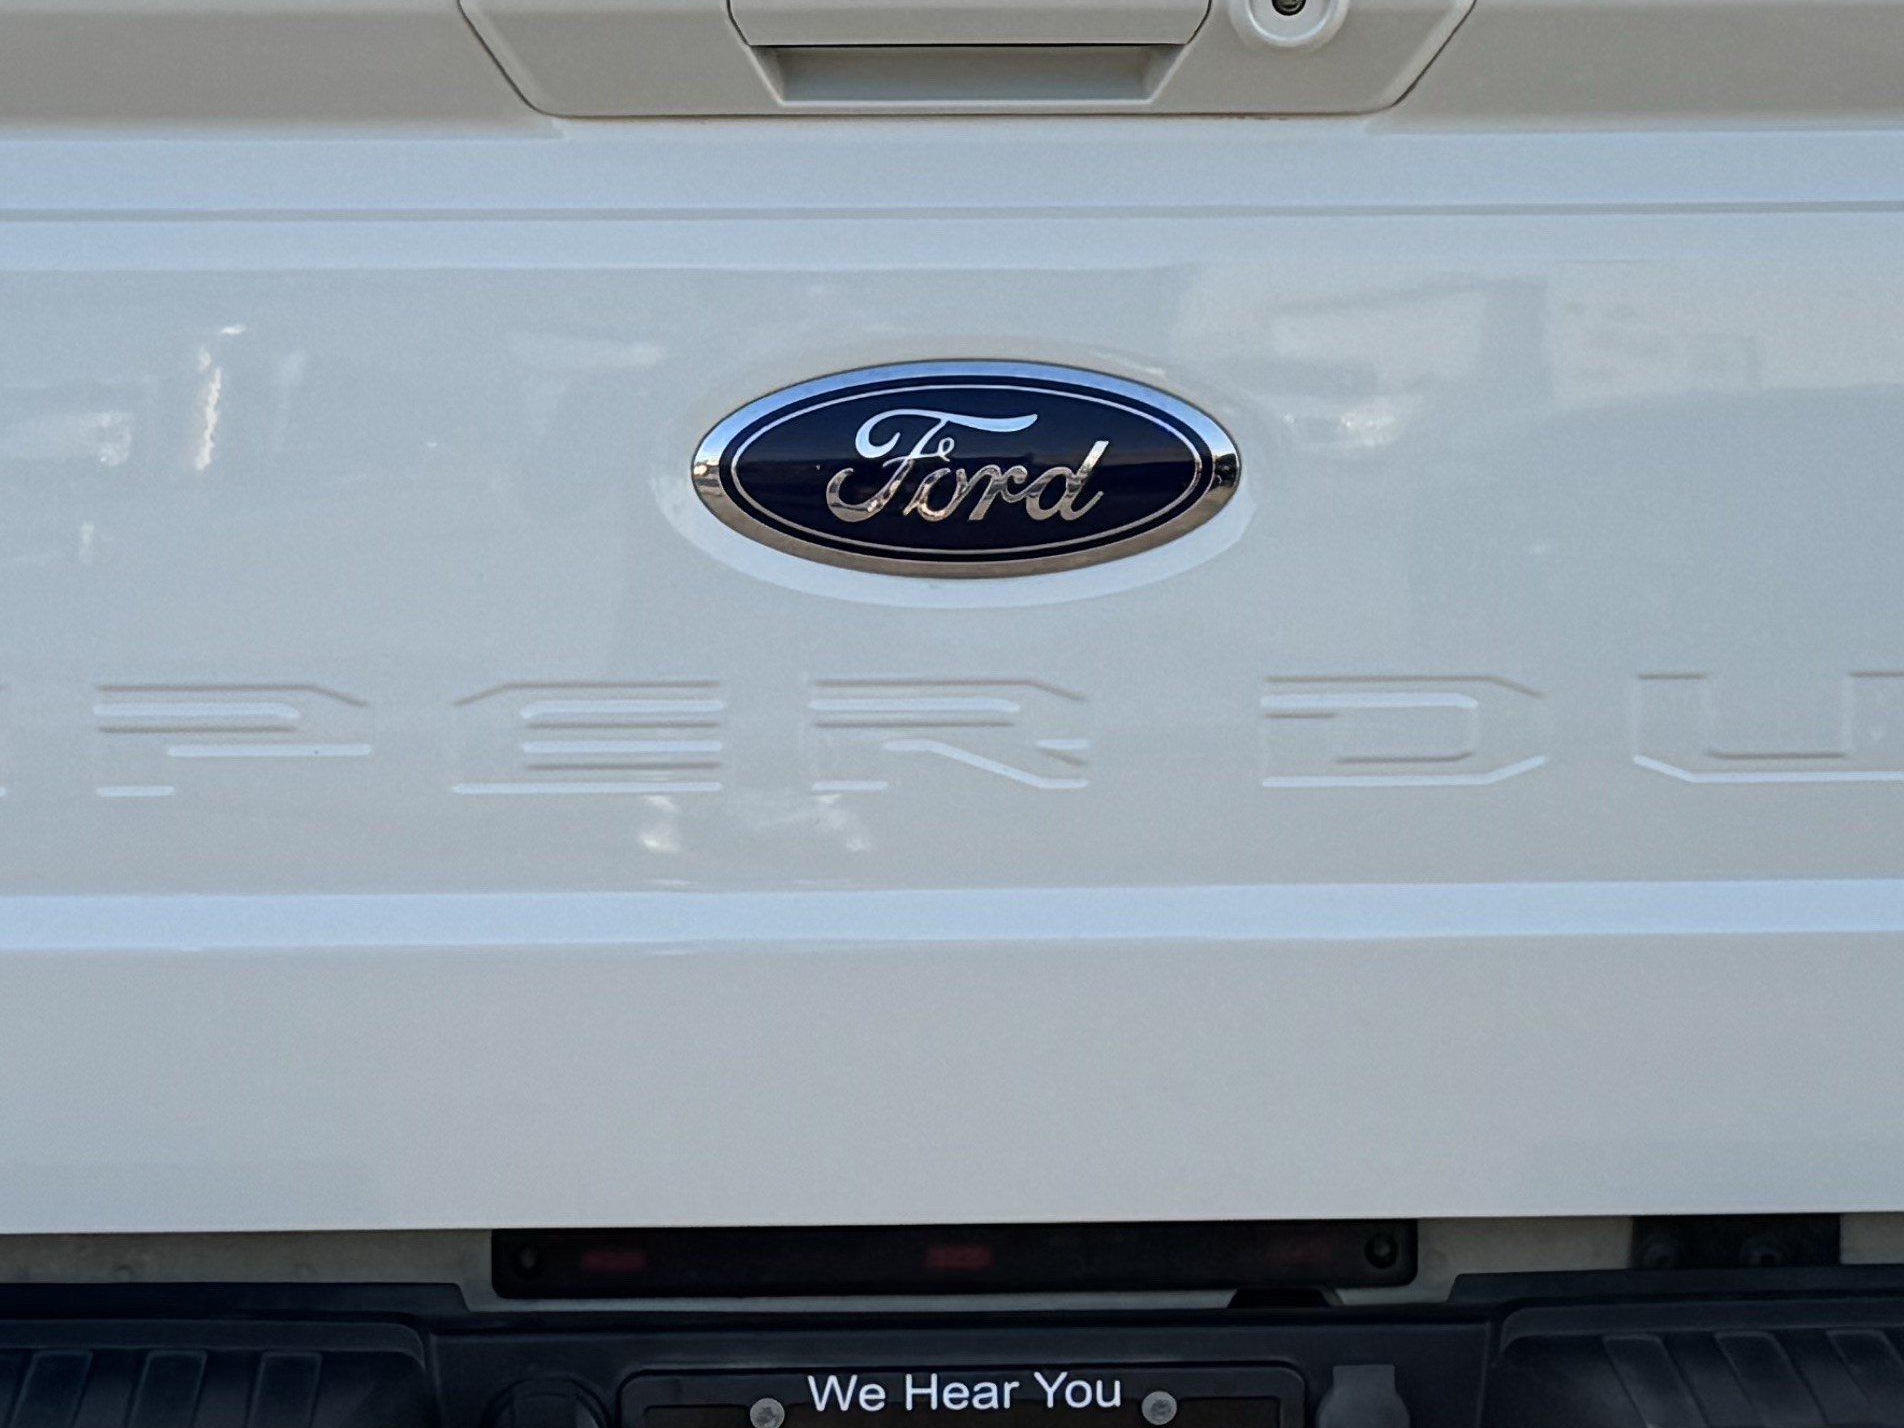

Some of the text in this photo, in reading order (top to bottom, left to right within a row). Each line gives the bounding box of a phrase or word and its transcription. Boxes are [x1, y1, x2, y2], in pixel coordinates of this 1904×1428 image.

[826, 407, 1110, 523] Ford
[807, 1371, 1122, 1412] We Hear You
